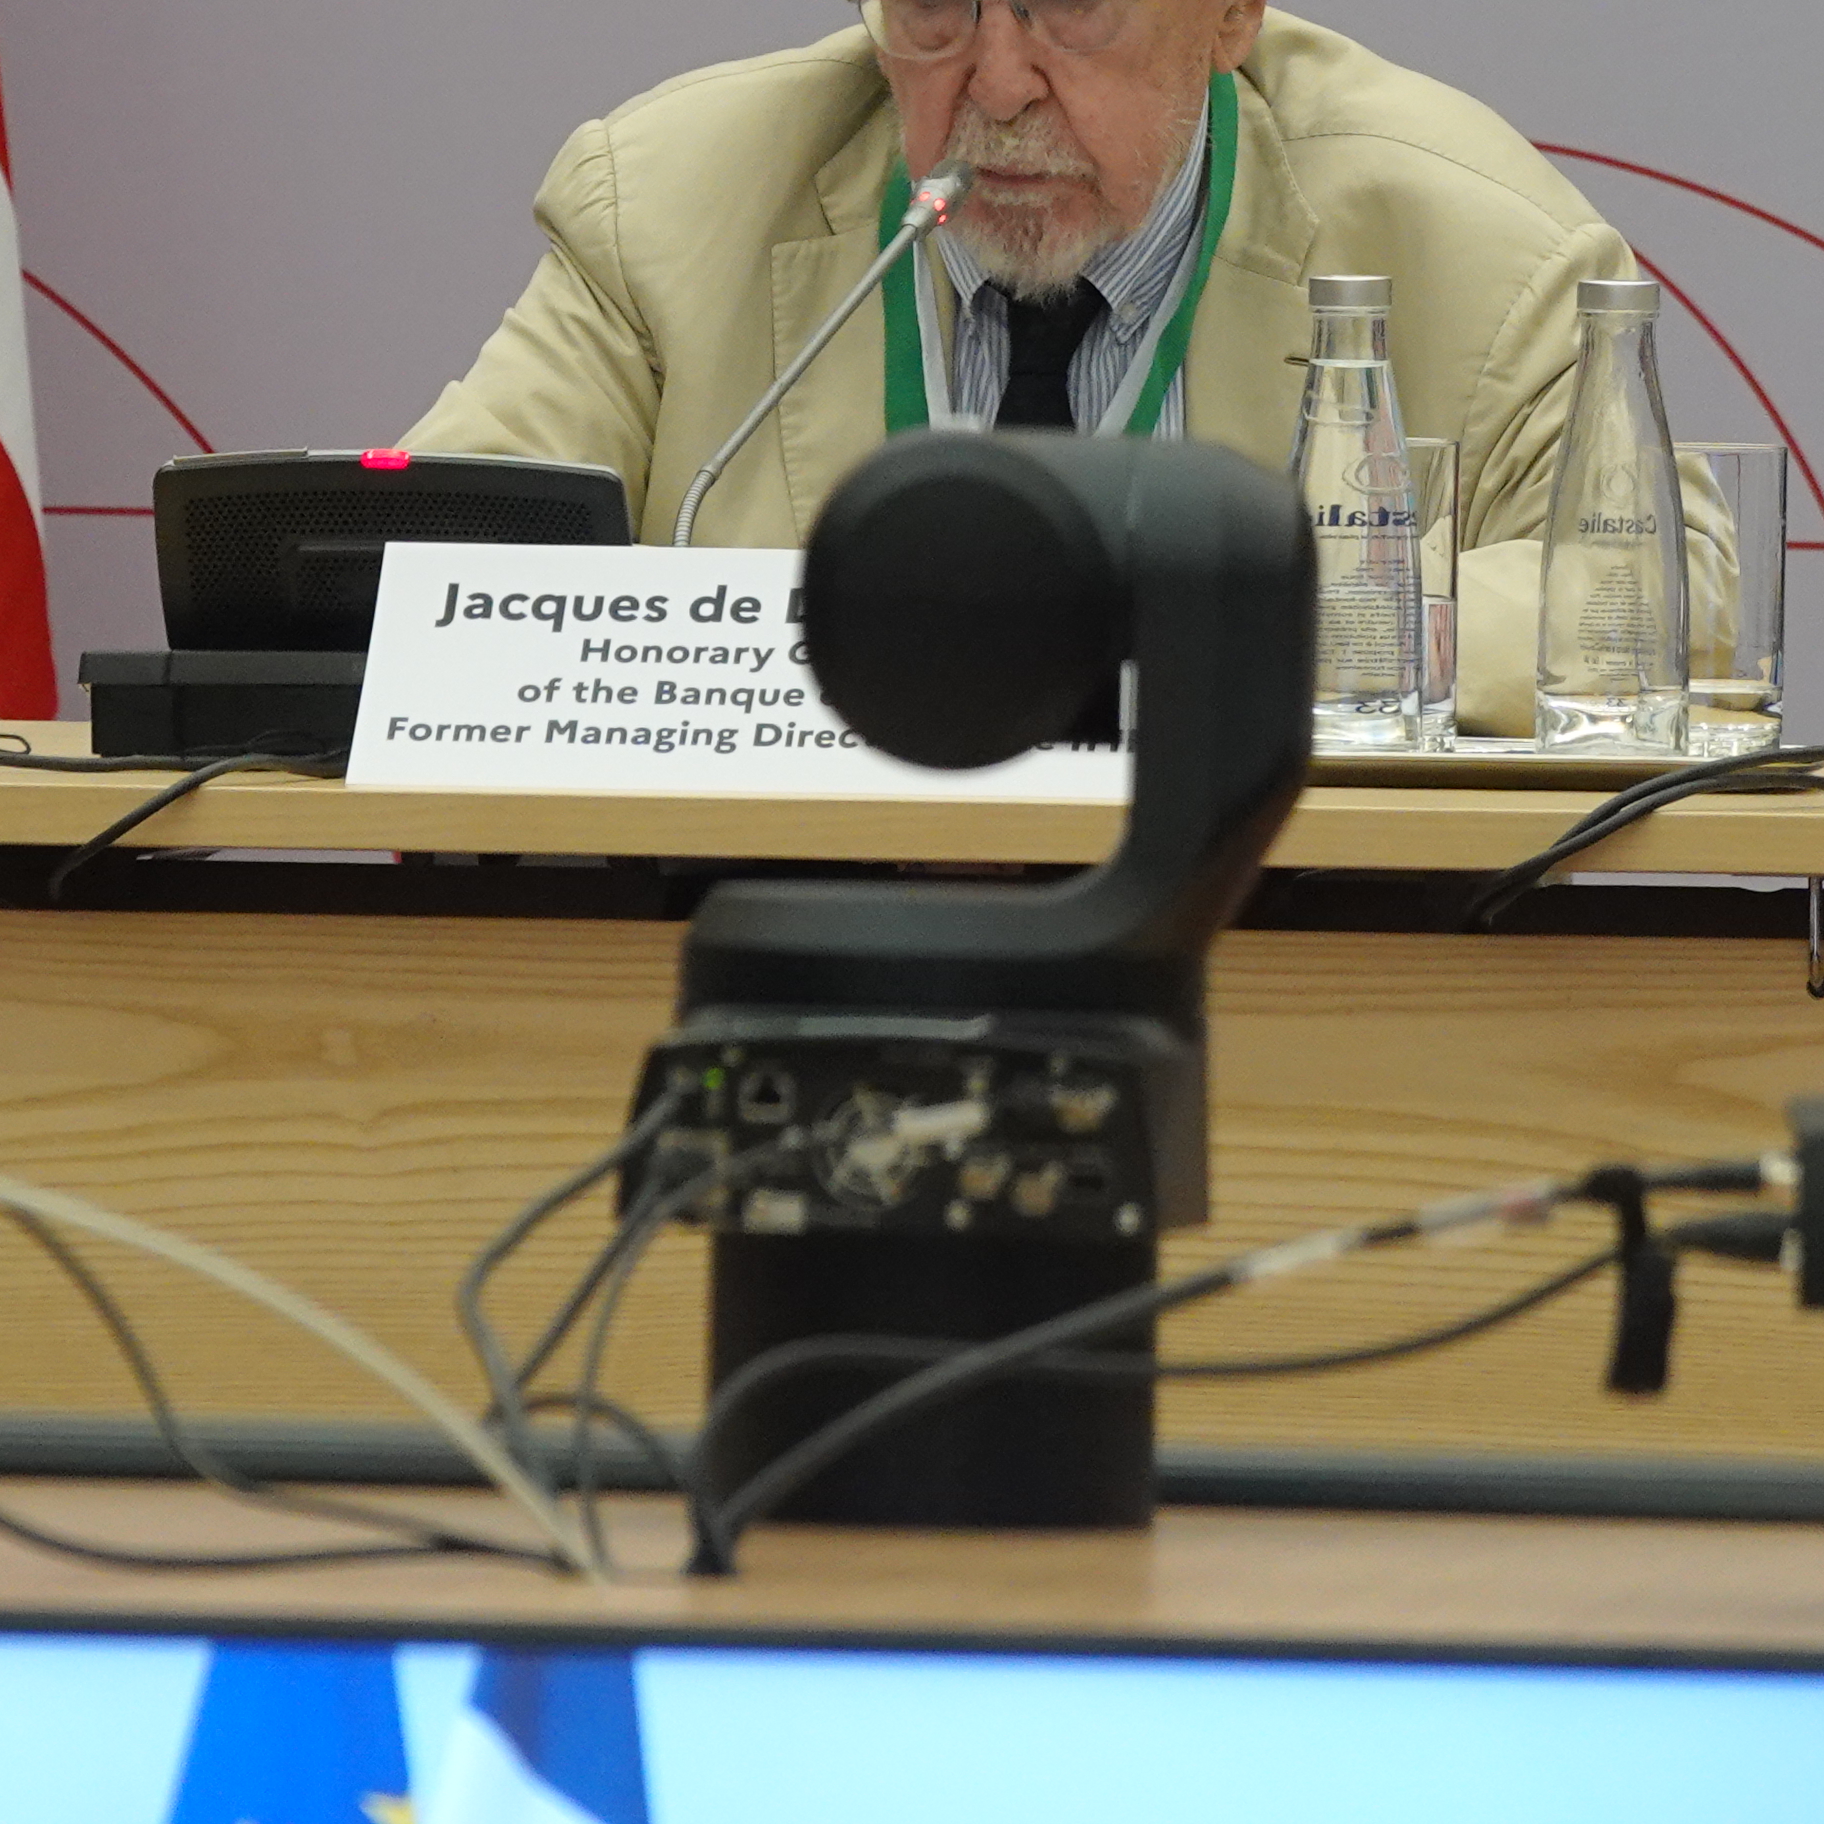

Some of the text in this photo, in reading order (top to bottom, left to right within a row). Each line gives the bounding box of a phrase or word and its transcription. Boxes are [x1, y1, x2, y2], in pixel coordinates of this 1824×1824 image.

[434, 582, 669, 633] Jacques
[688, 584, 762, 625] de
[580, 637, 775, 671] Honorary
[517, 676, 563, 704] of
[572, 677, 639, 705] the
[653, 679, 806, 711] Banque
[386, 716, 860, 753] Former Managing Direc
